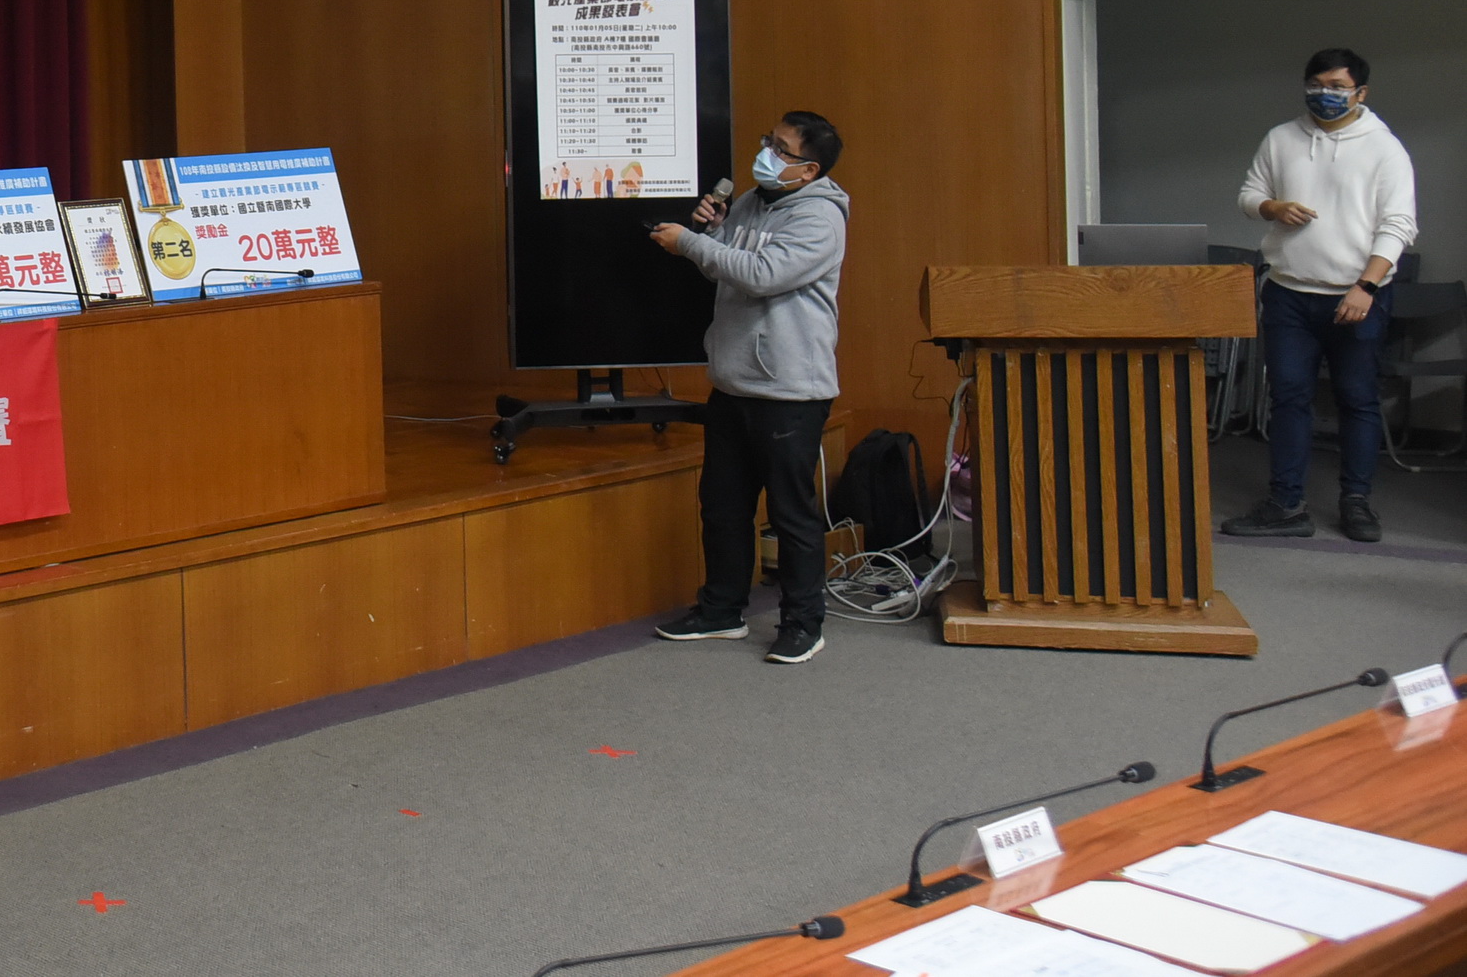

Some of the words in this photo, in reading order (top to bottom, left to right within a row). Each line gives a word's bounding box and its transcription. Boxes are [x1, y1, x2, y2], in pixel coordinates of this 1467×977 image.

[575, 3, 642, 21] 成果發表會
[189, 197, 312, 219] 獲獎單位：國立暨南國際大學
[194, 223, 230, 239] 獎勵金
[150, 238, 193, 261] 第二名
[238, 225, 342, 262] 20萬元整
